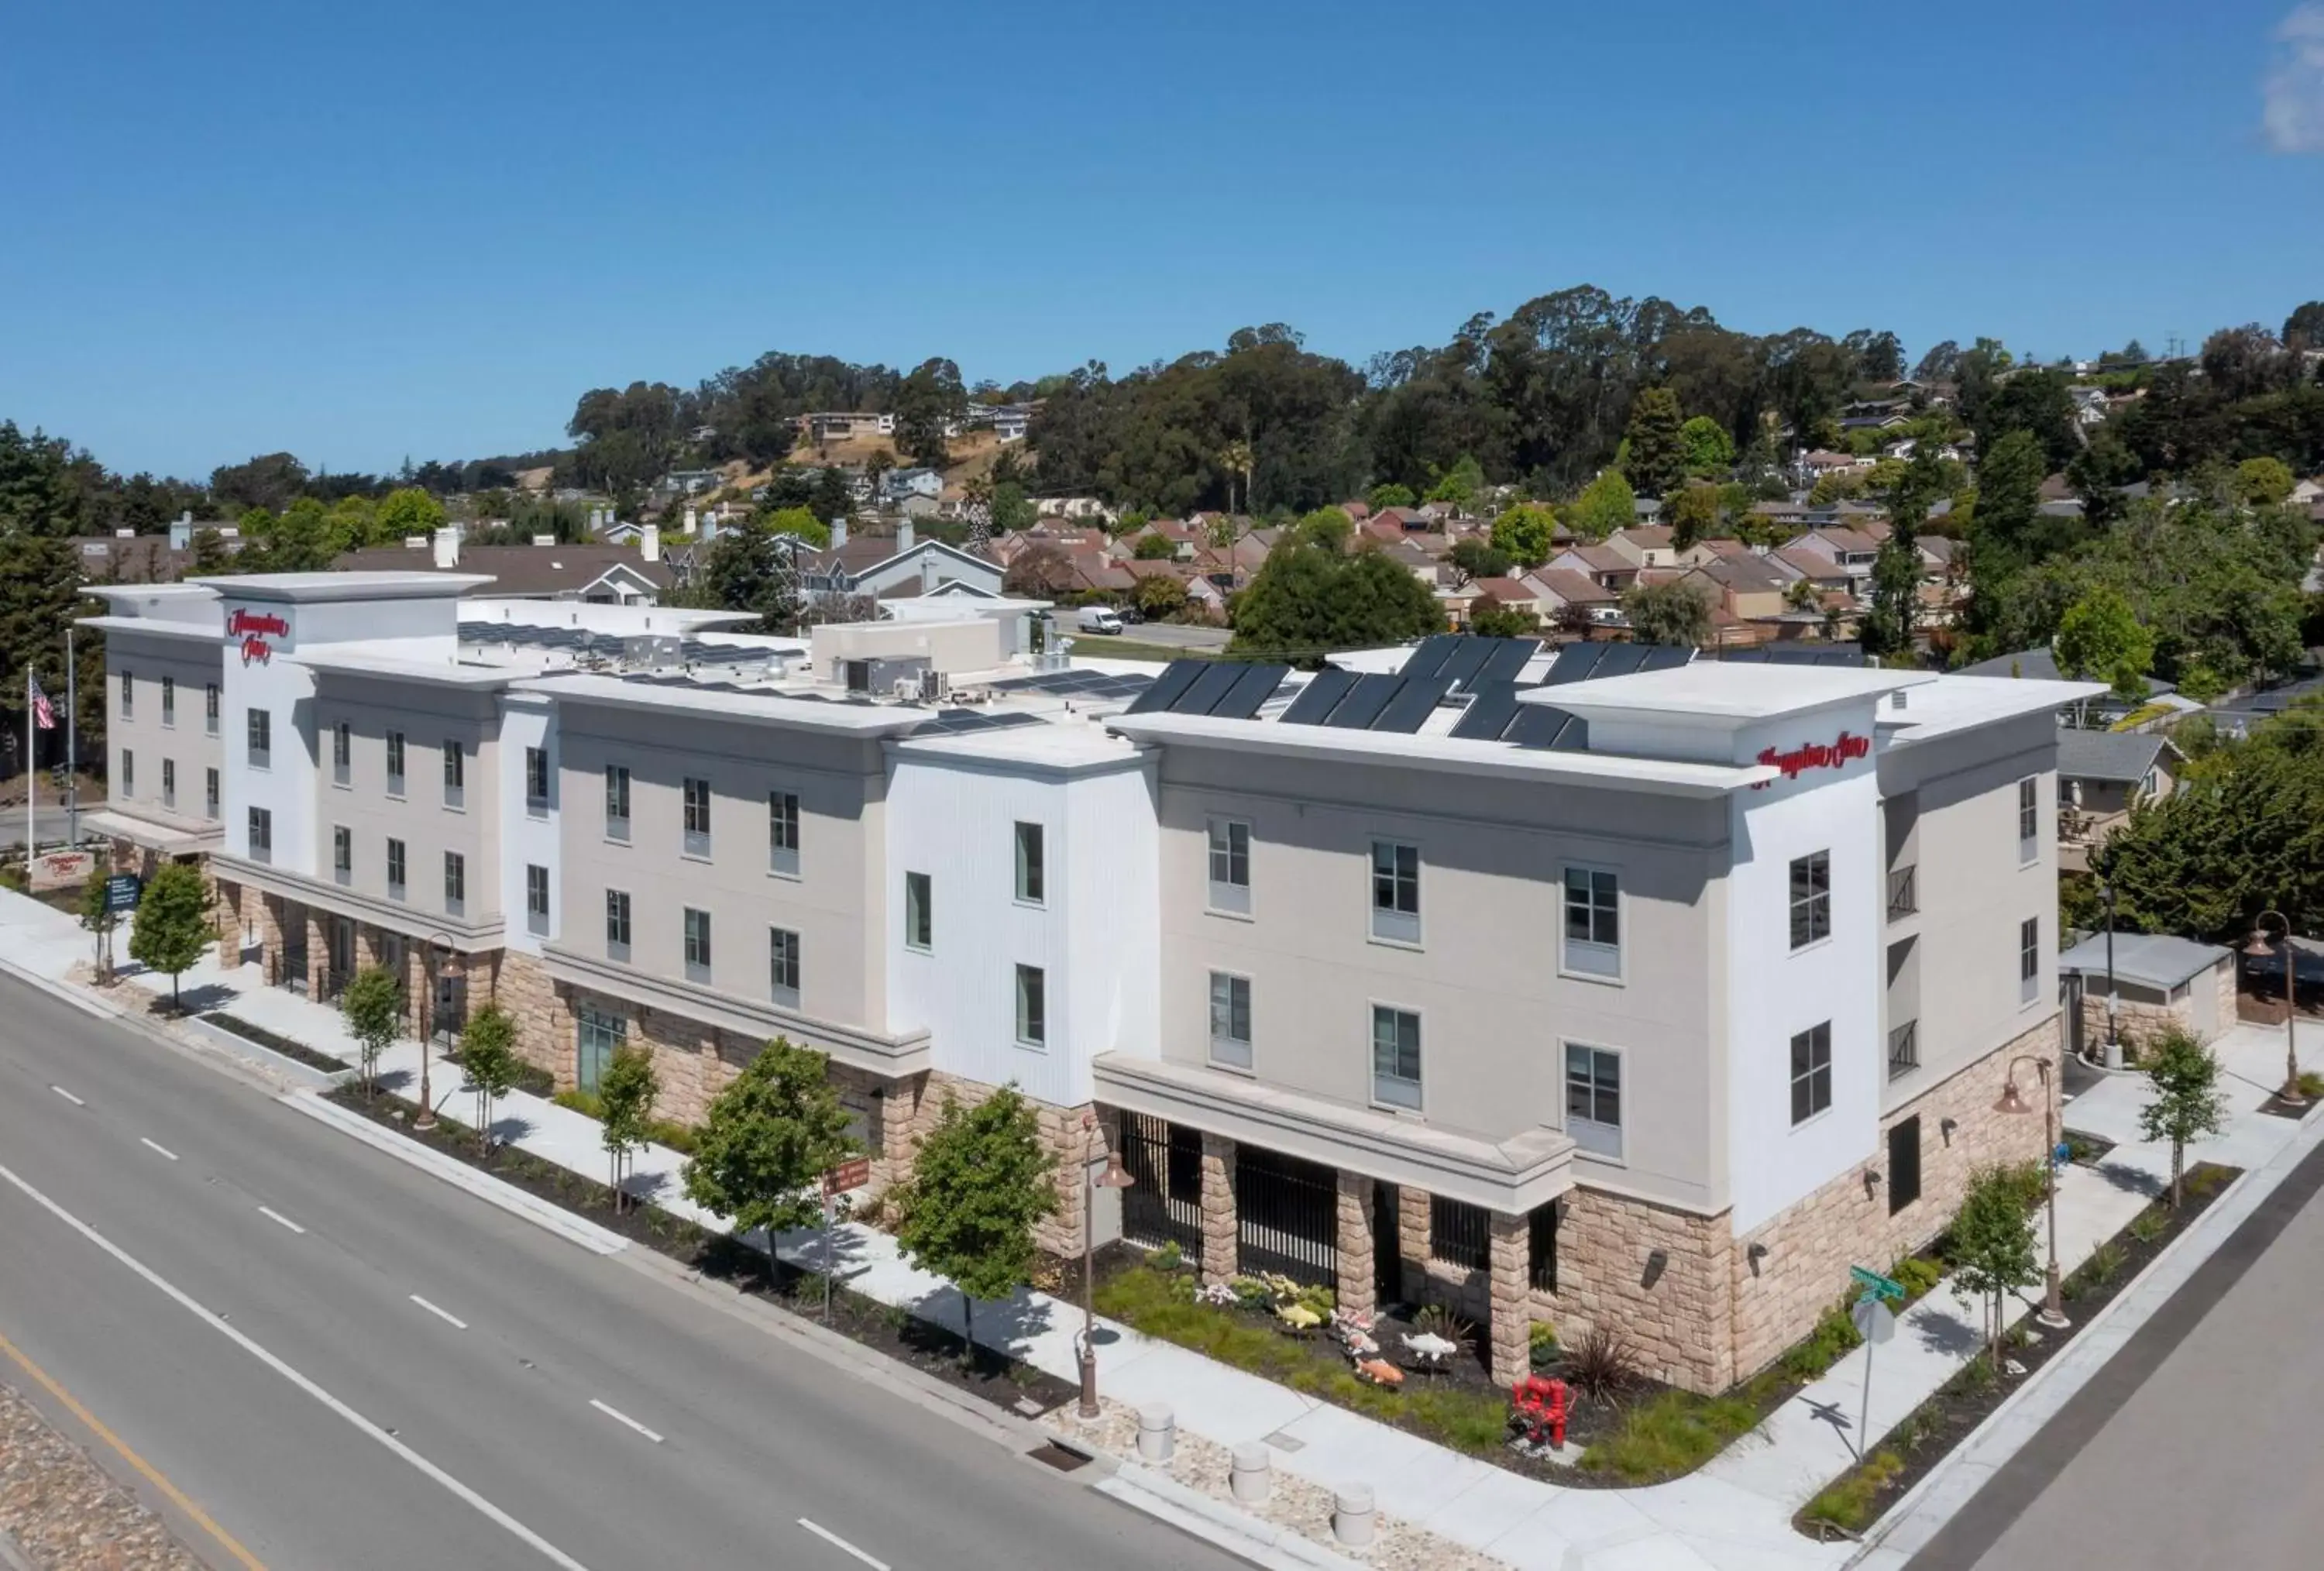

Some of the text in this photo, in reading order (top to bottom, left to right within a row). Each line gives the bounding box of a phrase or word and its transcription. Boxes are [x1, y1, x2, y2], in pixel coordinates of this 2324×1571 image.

[227, 607, 290, 638] Hampton
[242, 634, 272, 661] Inn
[1833, 731, 1869, 768] Inn
